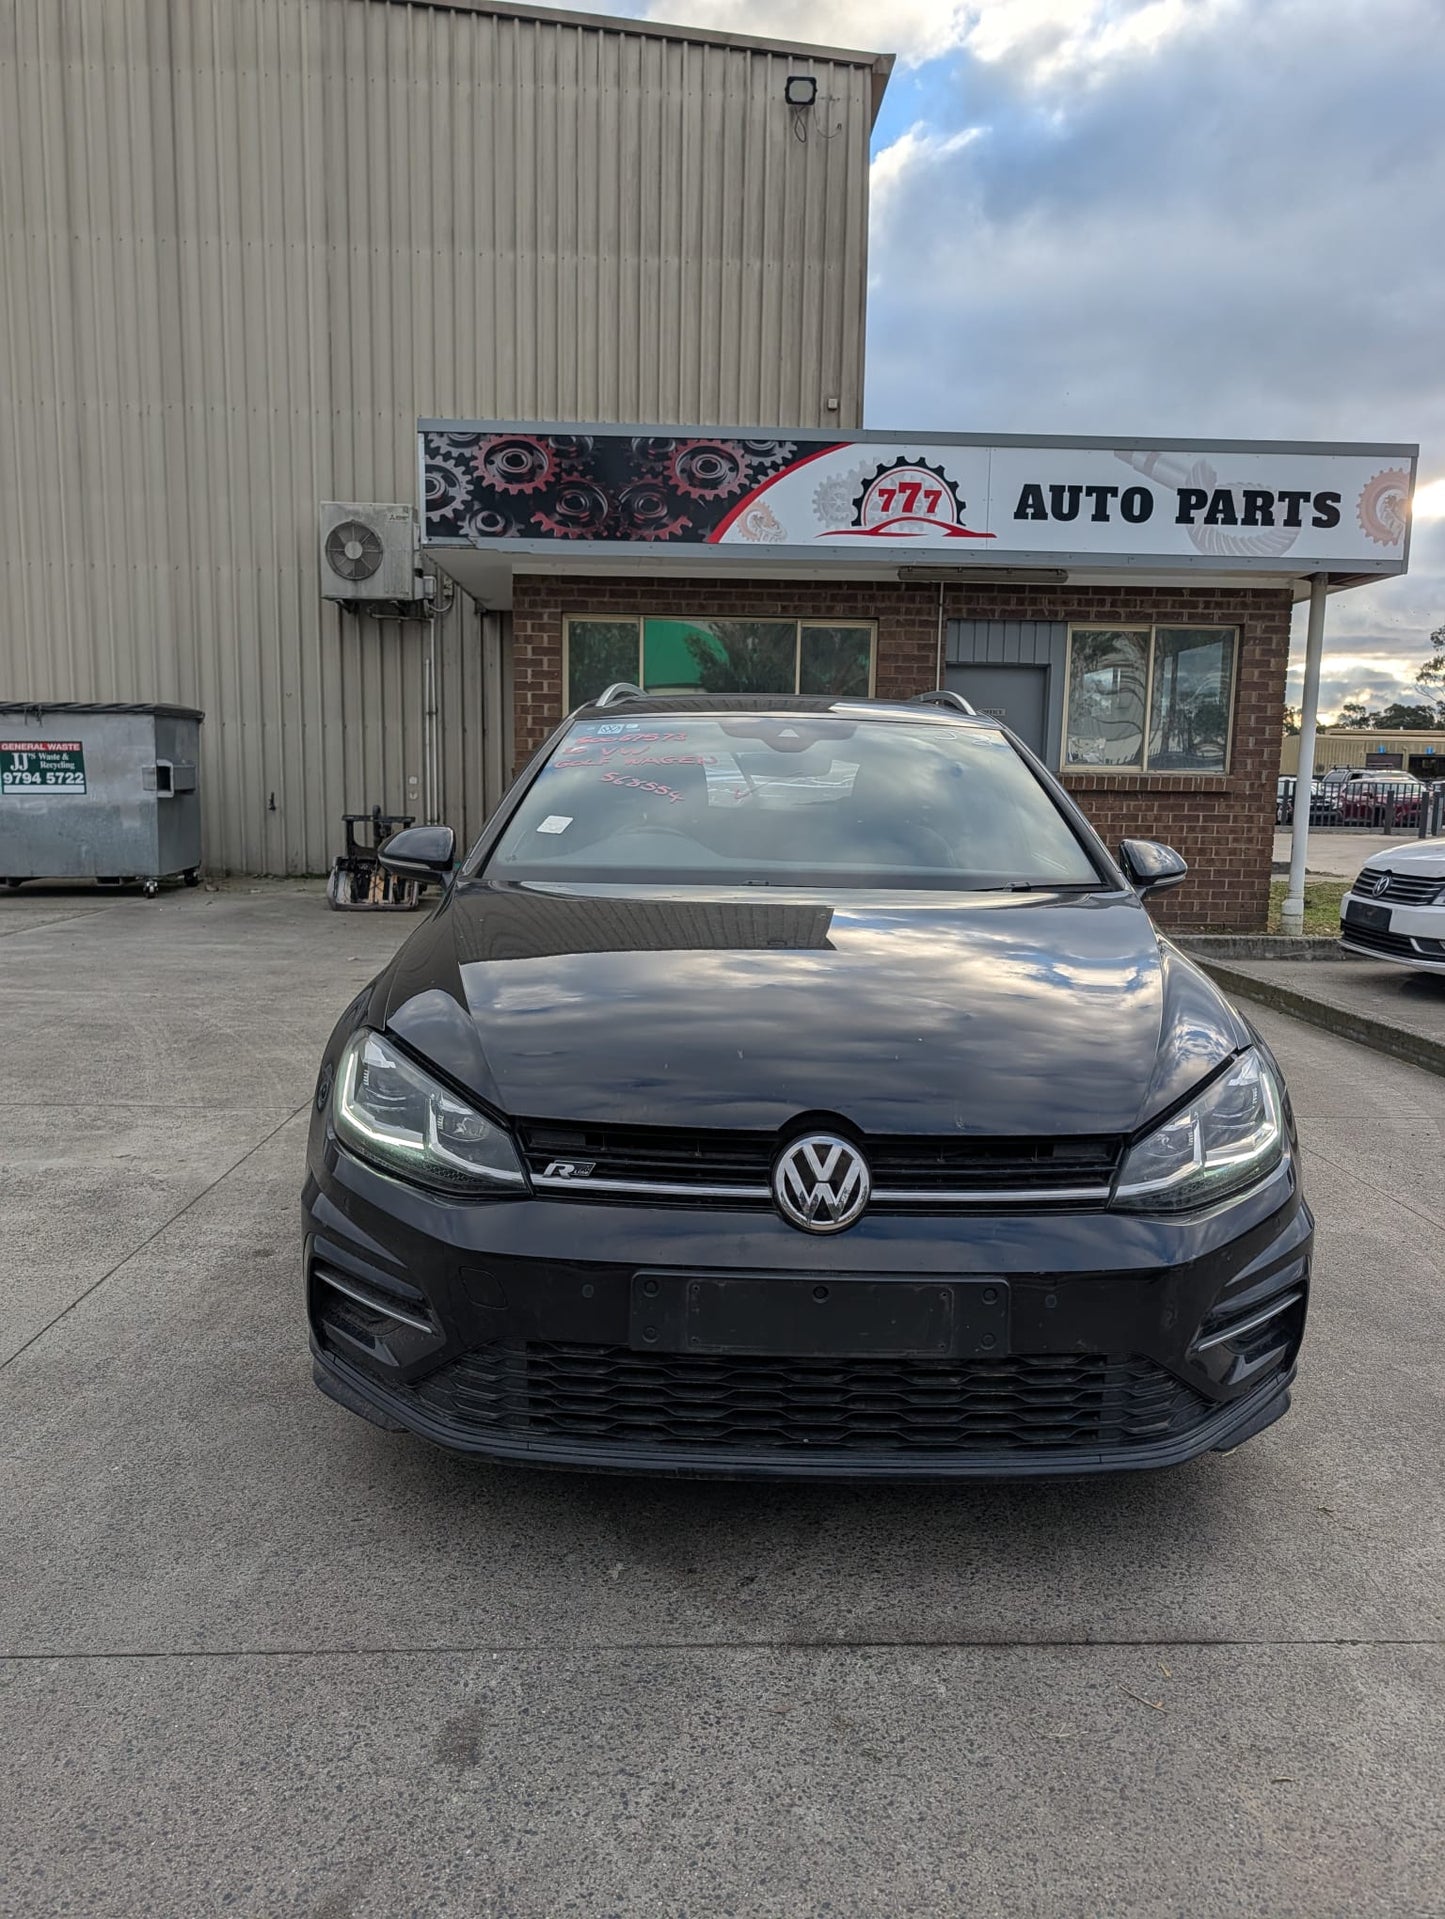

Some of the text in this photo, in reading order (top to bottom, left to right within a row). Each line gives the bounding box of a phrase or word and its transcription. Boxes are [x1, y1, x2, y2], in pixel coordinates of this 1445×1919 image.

[878, 481, 942, 513] 777
[1013, 483, 1342, 529] AUTO PARTS
[1, 743, 80, 751] GENERAL WASTE
[39, 752, 60, 760] Waste
[40, 761, 76, 770] Recycling
[2, 772, 85, 784] 9794 5722
